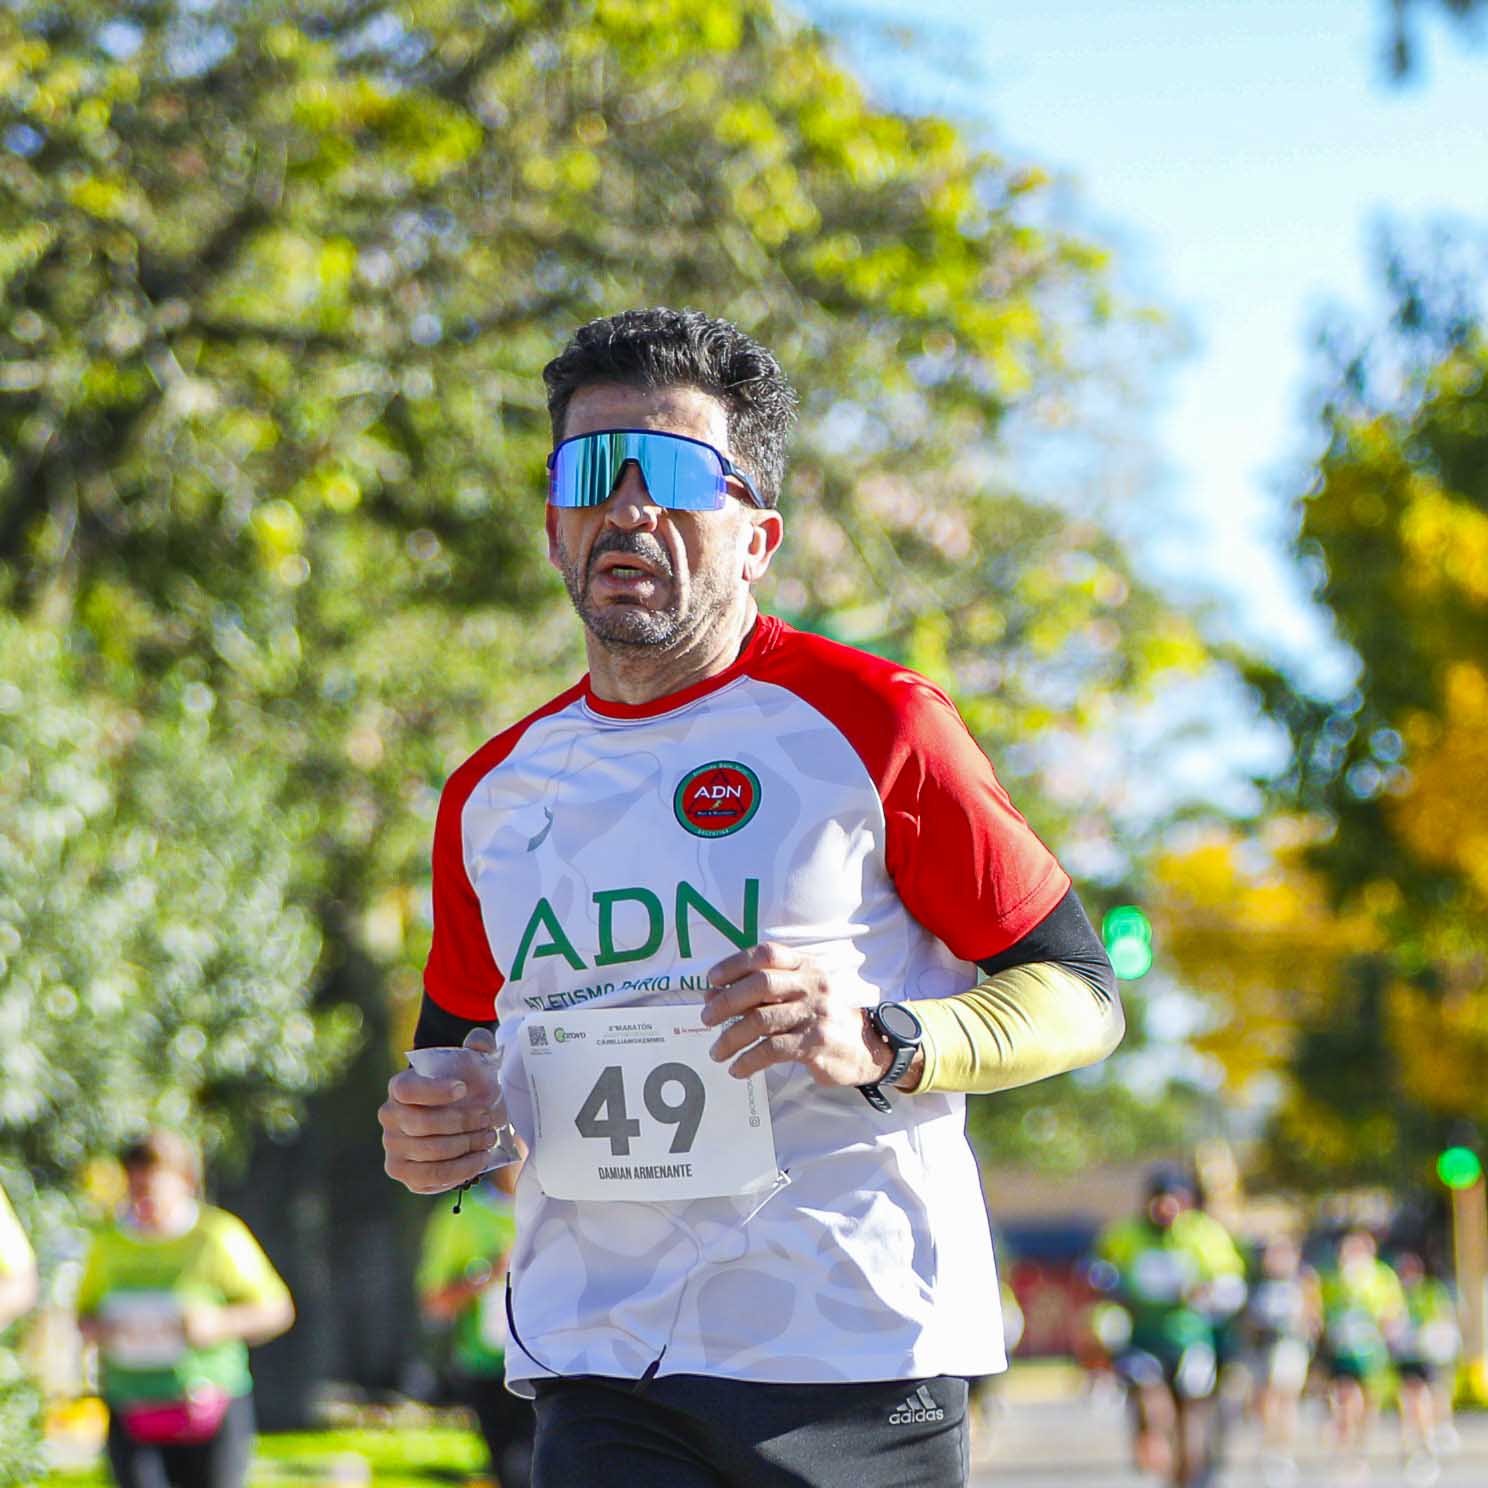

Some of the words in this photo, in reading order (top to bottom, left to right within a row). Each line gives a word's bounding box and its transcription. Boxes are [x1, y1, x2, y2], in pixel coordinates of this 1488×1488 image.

[694, 785, 741, 799] ADN
[509, 879, 759, 982] ADN
[574, 1062, 706, 1156] 49
[598, 1166, 632, 1180] DAMIAN
[634, 1163, 693, 1179] ARMENANTE
[889, 1408, 944, 1424] adidas
